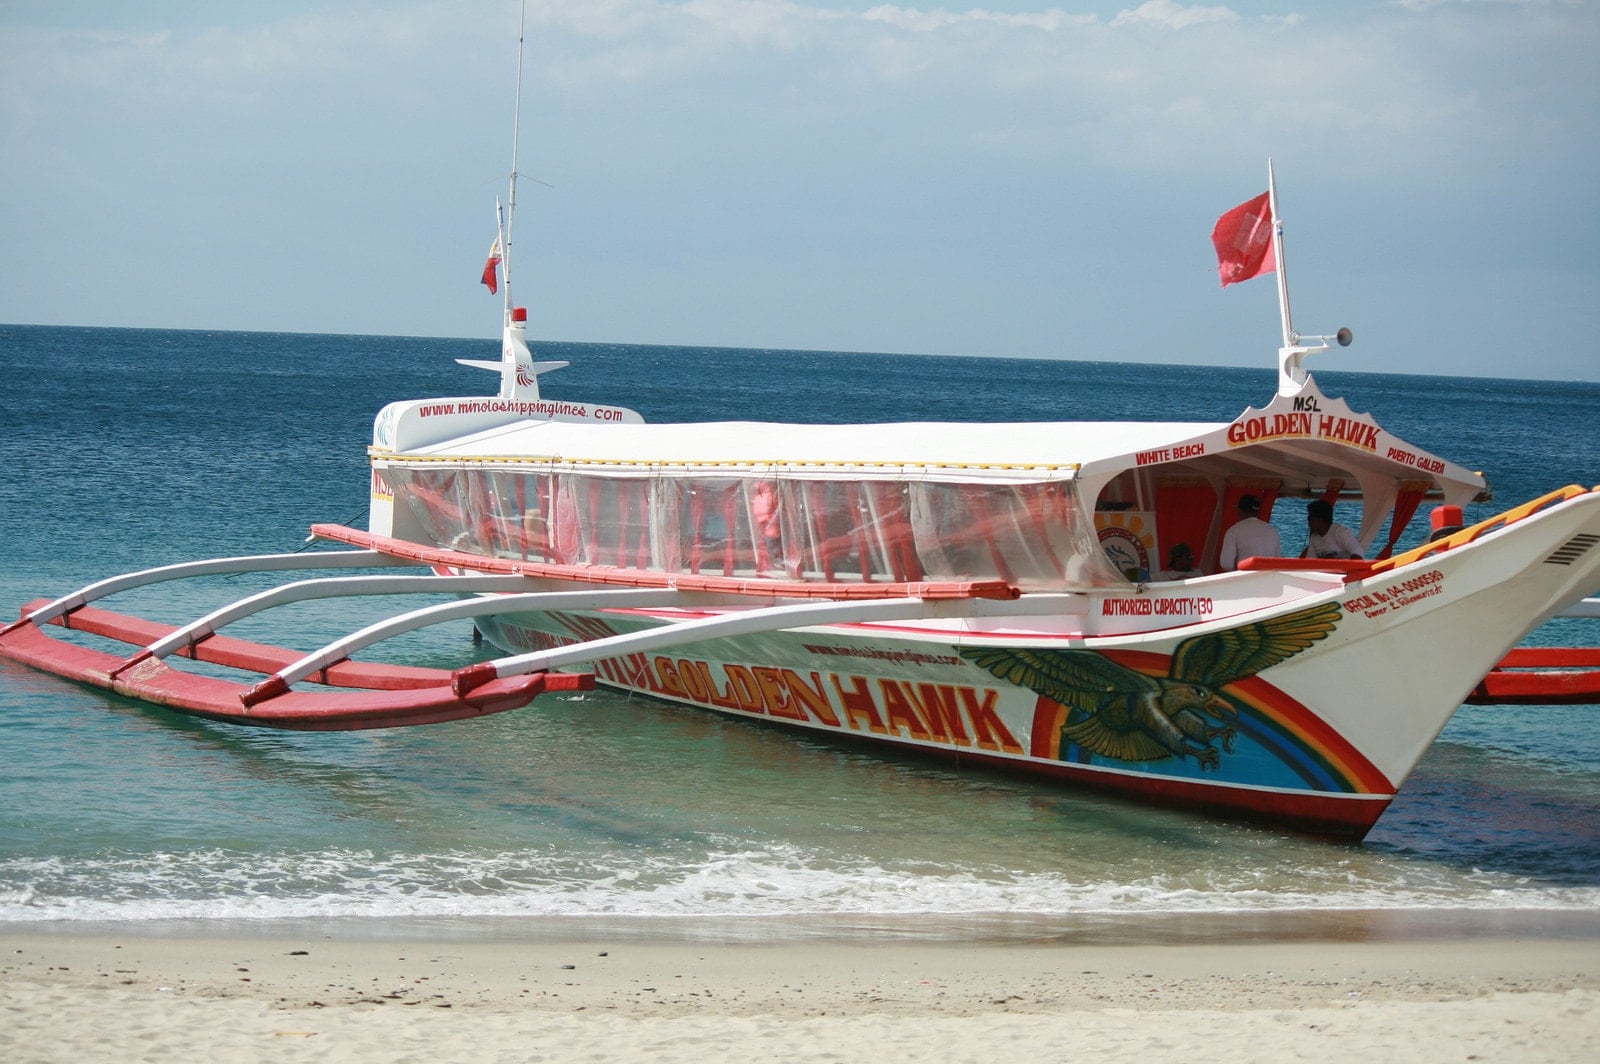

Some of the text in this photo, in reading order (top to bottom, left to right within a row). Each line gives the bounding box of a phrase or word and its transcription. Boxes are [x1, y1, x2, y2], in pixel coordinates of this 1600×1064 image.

[1293, 395, 1321, 412] MSL
[1227, 412, 1381, 453] GOLDEN HAWK
[1136, 443, 1204, 466] WHITE BEACH
[1387, 447, 1445, 475] PUERTO GALERA
[1102, 598, 1153, 616] AUTHORIZED
[653, 655, 1025, 756] GOLDEN HAWK
